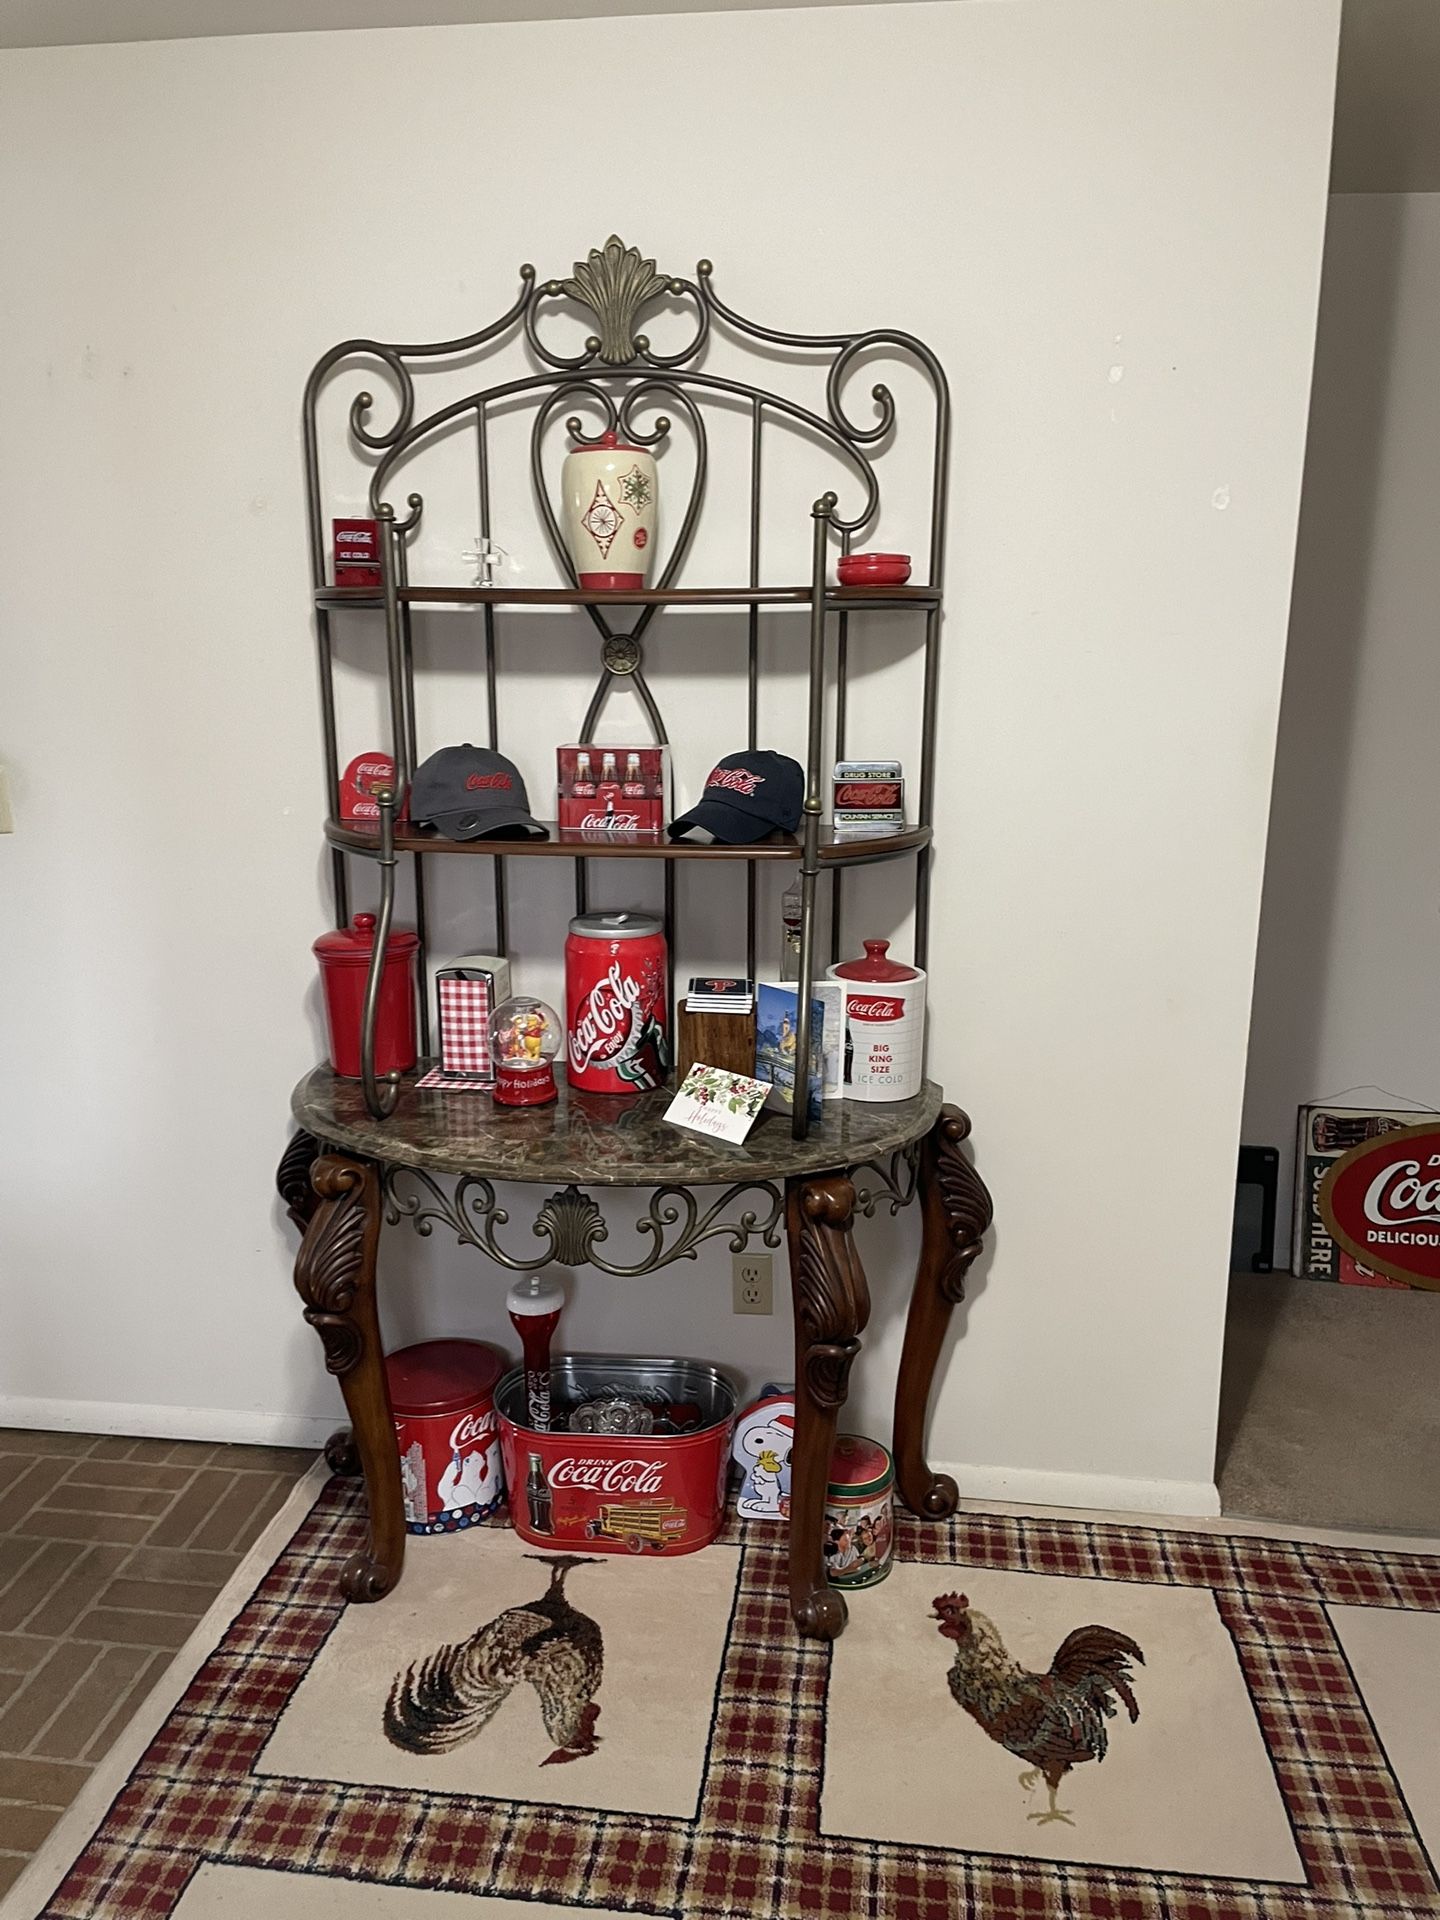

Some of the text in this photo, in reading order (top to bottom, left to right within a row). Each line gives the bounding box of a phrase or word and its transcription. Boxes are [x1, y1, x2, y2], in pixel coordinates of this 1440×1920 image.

[836, 784, 900, 805] Coca-Cola
[847, 999, 895, 1017] Coca-Cola
[568, 960, 641, 1074] Coca-Cola
[605, 1031, 625, 1055] Enjoy
[873, 1044, 890, 1052] BIG
[868, 1055, 893, 1063] KING
[871, 1065, 890, 1074] SIZE
[858, 1074, 904, 1084] ICE COLD
[1366, 1230, 1440, 1247] DELICIOU
[577, 1458, 616, 1467] DRINK
[547, 1457, 668, 1493] Coca-Cola
